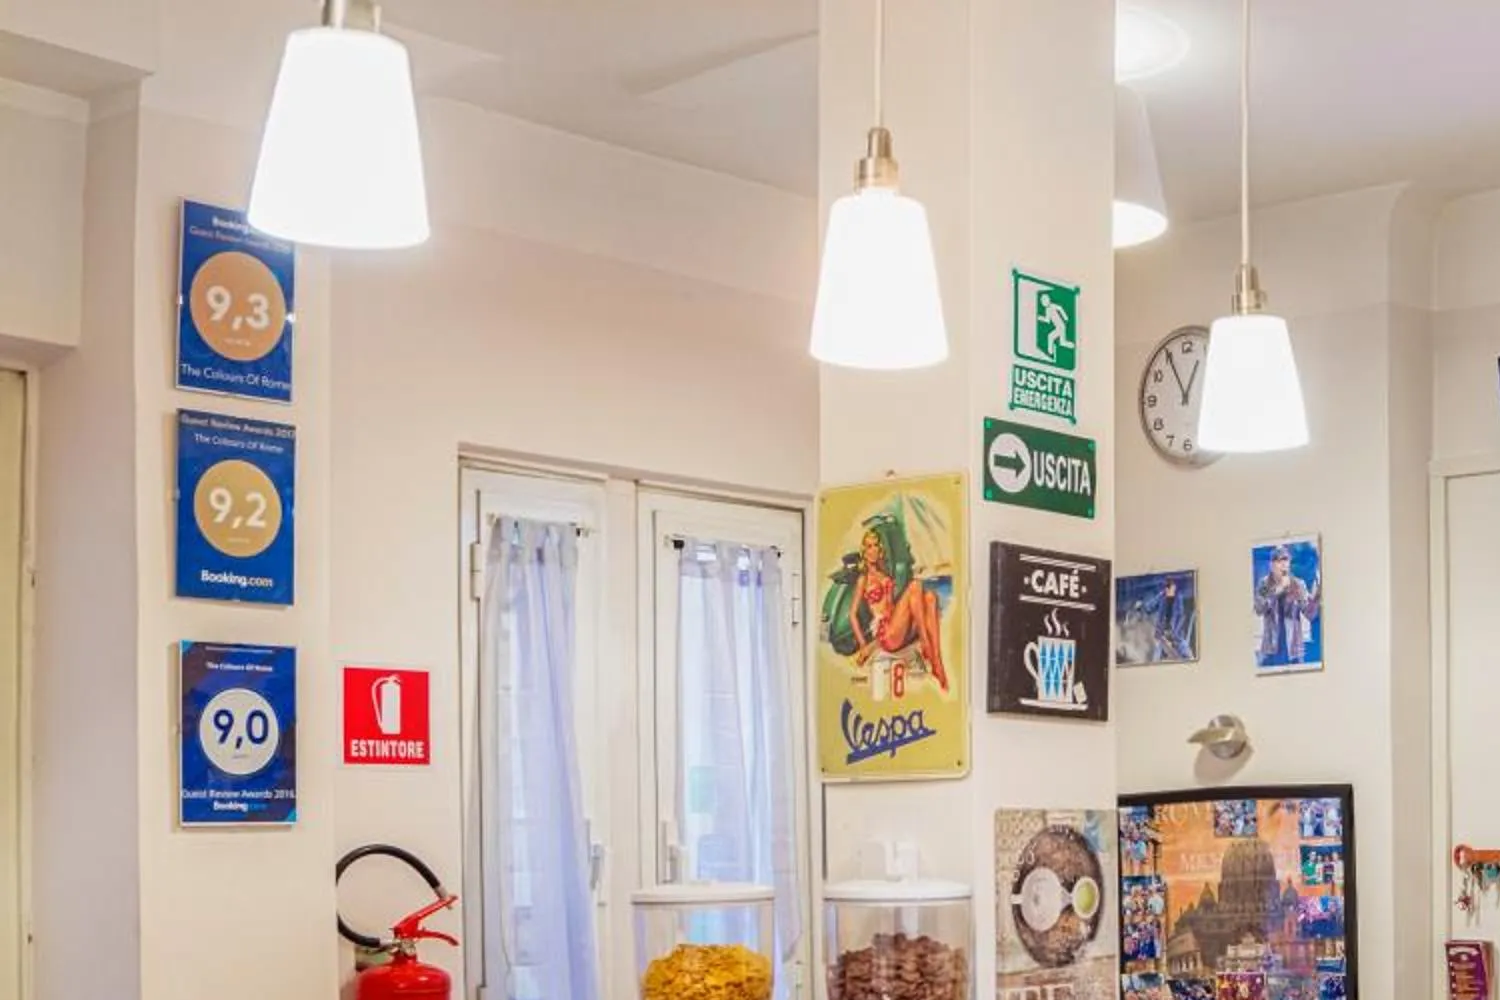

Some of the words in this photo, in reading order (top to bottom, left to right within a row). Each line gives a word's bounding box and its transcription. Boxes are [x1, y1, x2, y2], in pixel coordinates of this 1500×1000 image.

[206, 285, 270, 331] 9,3
[1181, 340, 1193, 354] 12
[180, 363, 200, 376] The
[246, 373, 260, 385] Of
[1014, 367, 1073, 399] USCITA
[1153, 369, 1164, 383] 10
[1013, 387, 1073, 417] EMERGENZA
[1147, 394, 1158, 408] 9
[194, 432, 210, 445] The
[1183, 438, 1192, 452] 6
[1033, 450, 1092, 497] USCITA
[208, 487, 267, 529] 9,2
[200, 568, 274, 589] Booking.com
[213, 708, 270, 750] 9,0
[840, 697, 937, 765] Vespa
[350, 738, 425, 759] ESTINTORE
